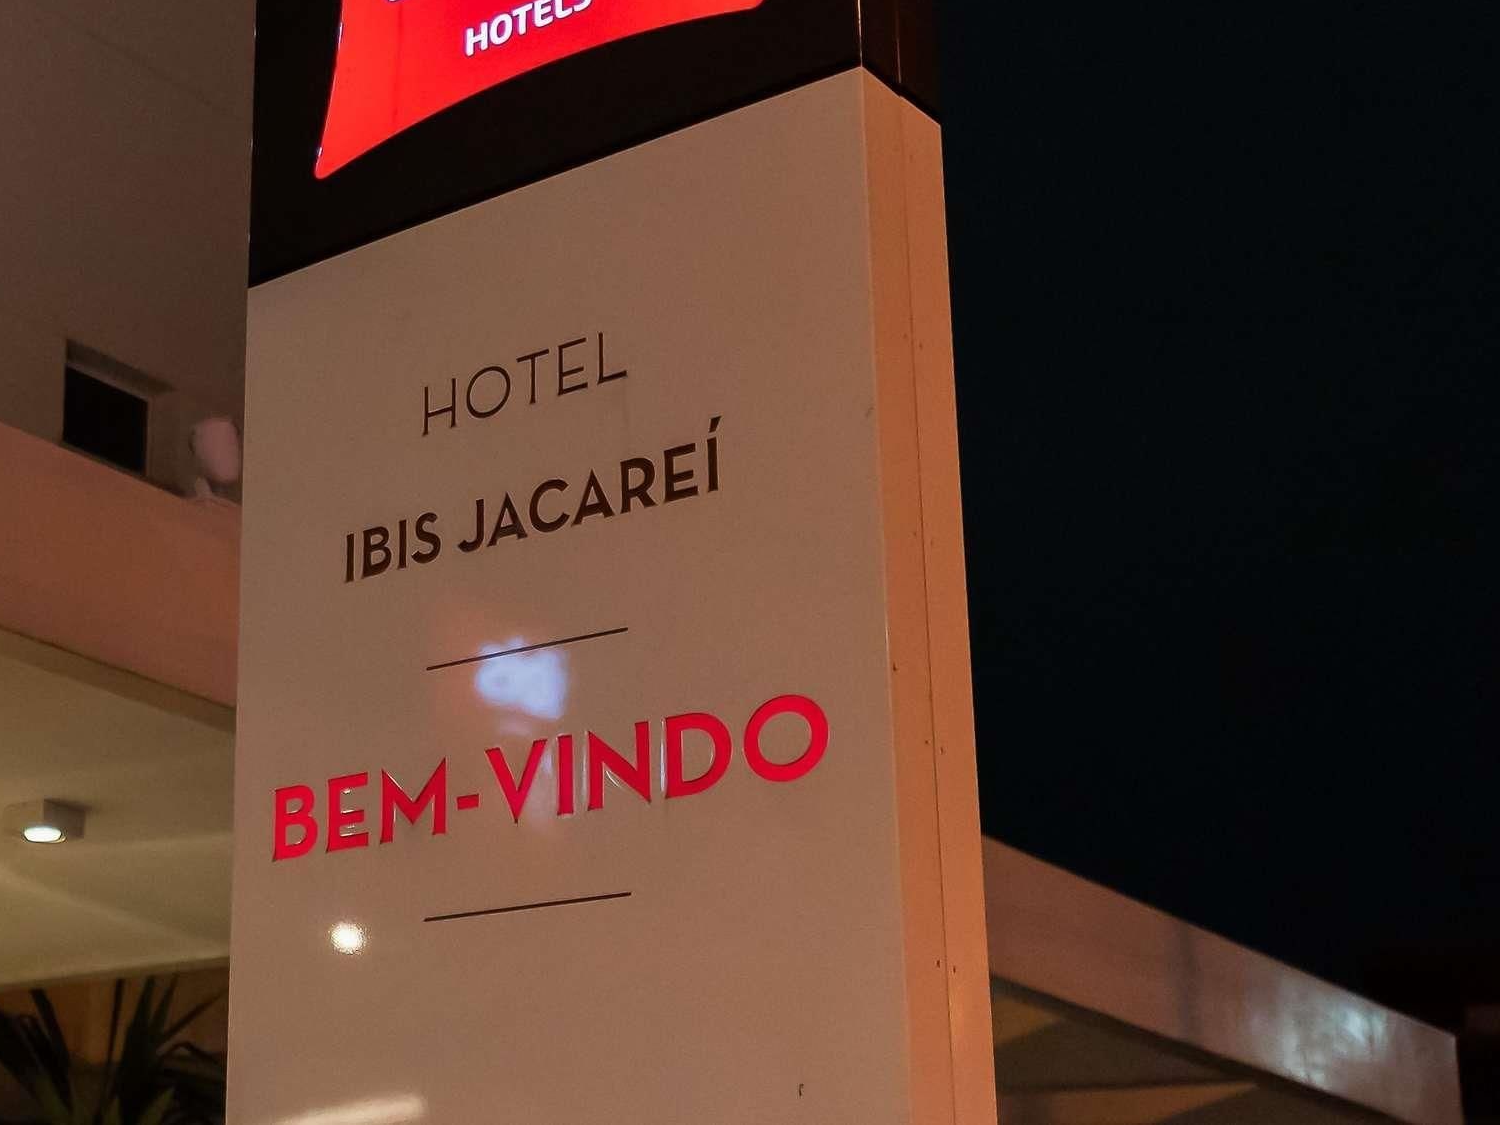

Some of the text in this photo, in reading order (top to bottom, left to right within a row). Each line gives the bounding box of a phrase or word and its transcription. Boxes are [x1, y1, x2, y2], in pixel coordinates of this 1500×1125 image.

[421, 331, 628, 437] HOTEL
[344, 416, 723, 583] IBIS JACAREÍ
[271, 694, 830, 863] BEM-VINDO
